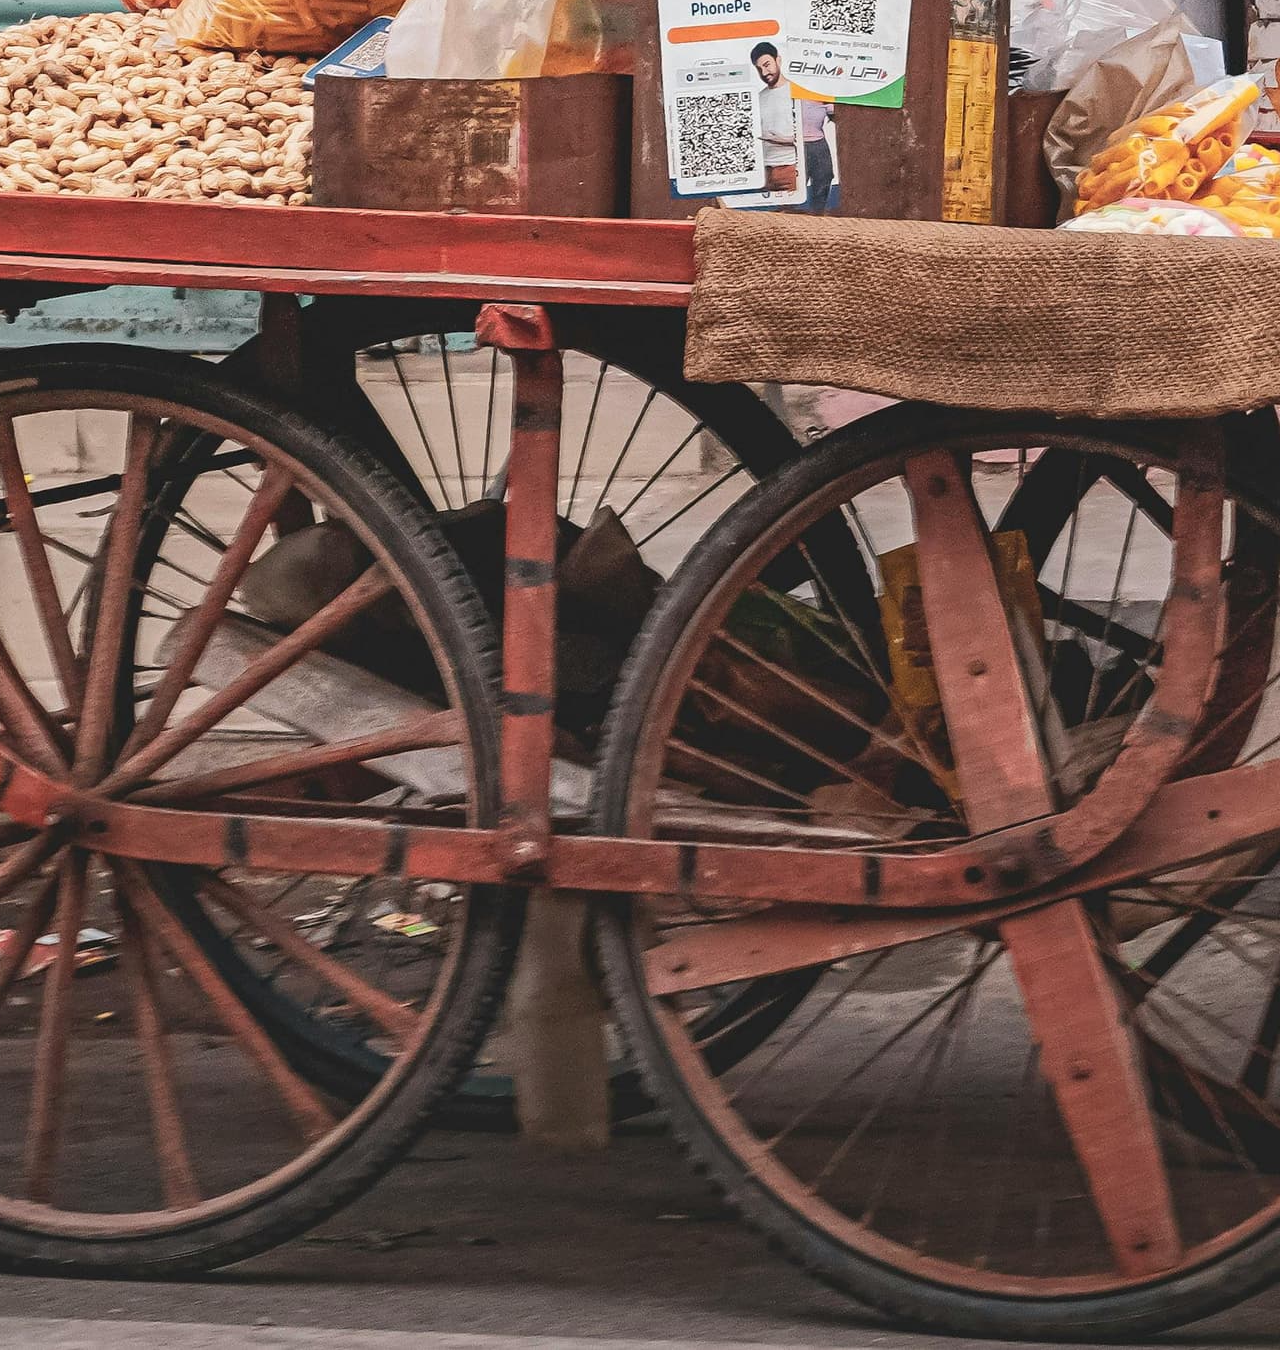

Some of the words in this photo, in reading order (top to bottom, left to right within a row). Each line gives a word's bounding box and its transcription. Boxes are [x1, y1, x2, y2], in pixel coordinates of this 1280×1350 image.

[691, 0, 752, 16] PhonePe
[789, 61, 836, 76] BHIM
[850, 66, 882, 79] UPI
